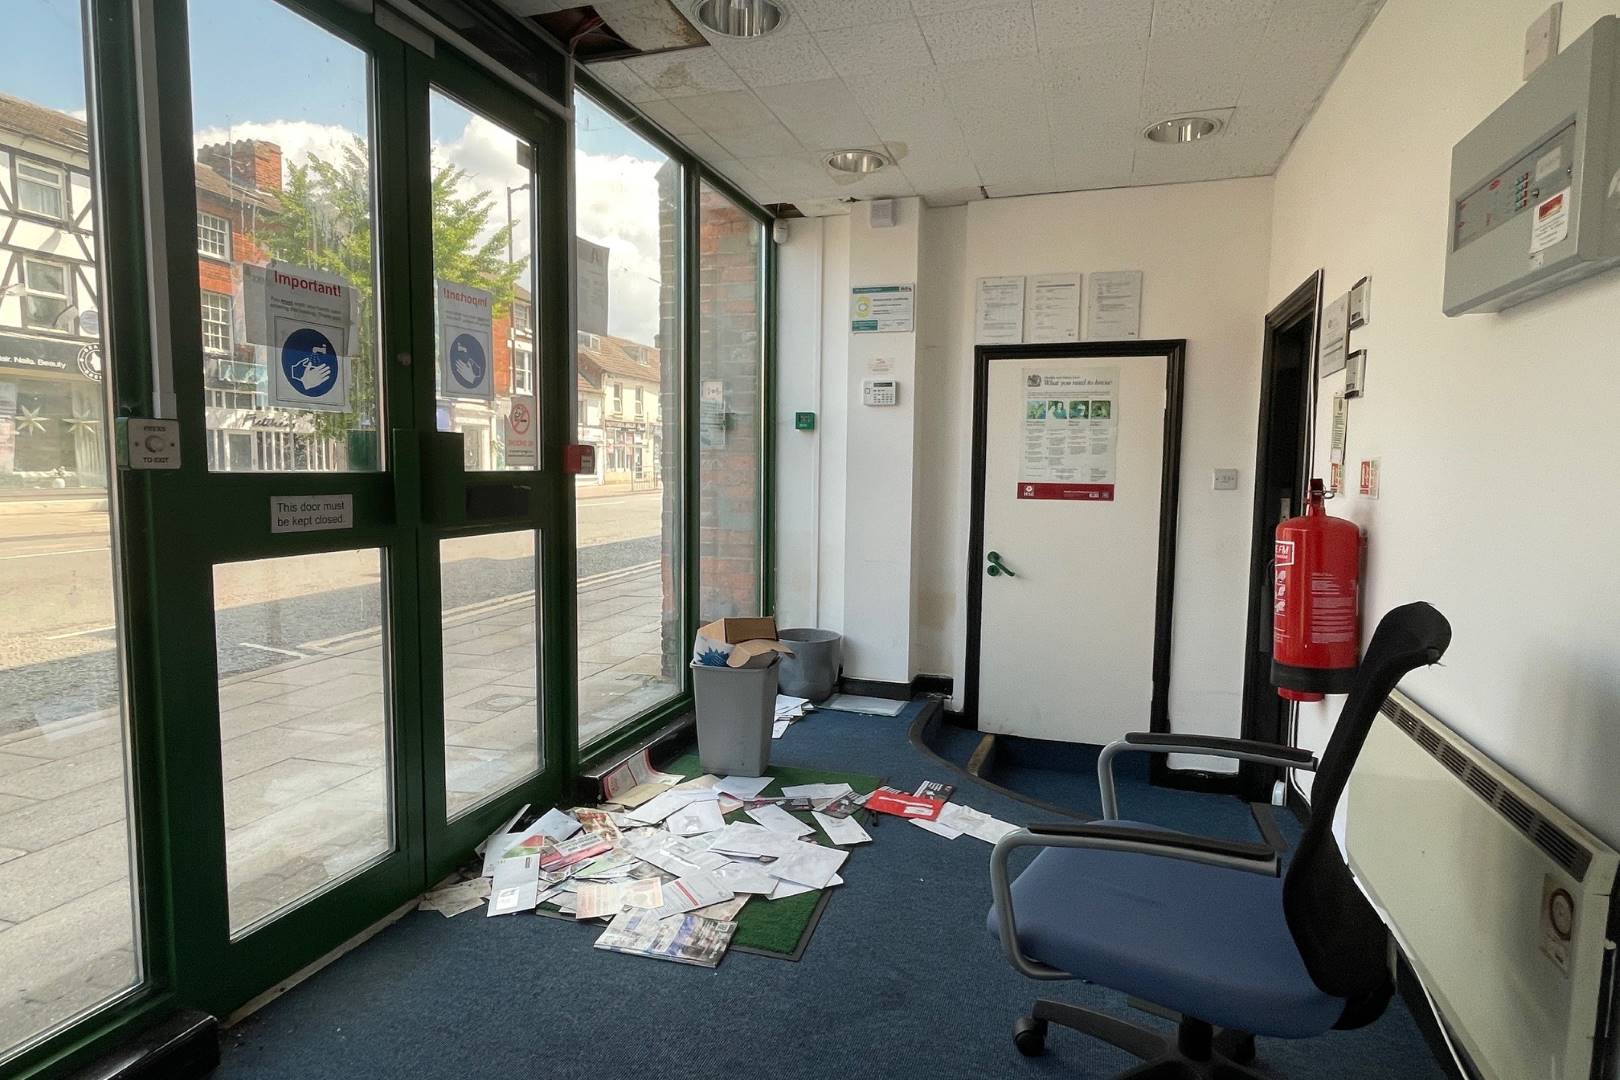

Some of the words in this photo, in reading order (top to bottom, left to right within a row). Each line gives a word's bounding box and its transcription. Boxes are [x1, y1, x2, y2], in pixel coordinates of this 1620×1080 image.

[274, 270, 341, 297] Important!
[37, 358, 66, 369] Beauty
[276, 502, 297, 512] This
[300, 501, 321, 512] door
[323, 500, 345, 511] must
[277, 516, 290, 527] be
[292, 515, 313, 527] kept
